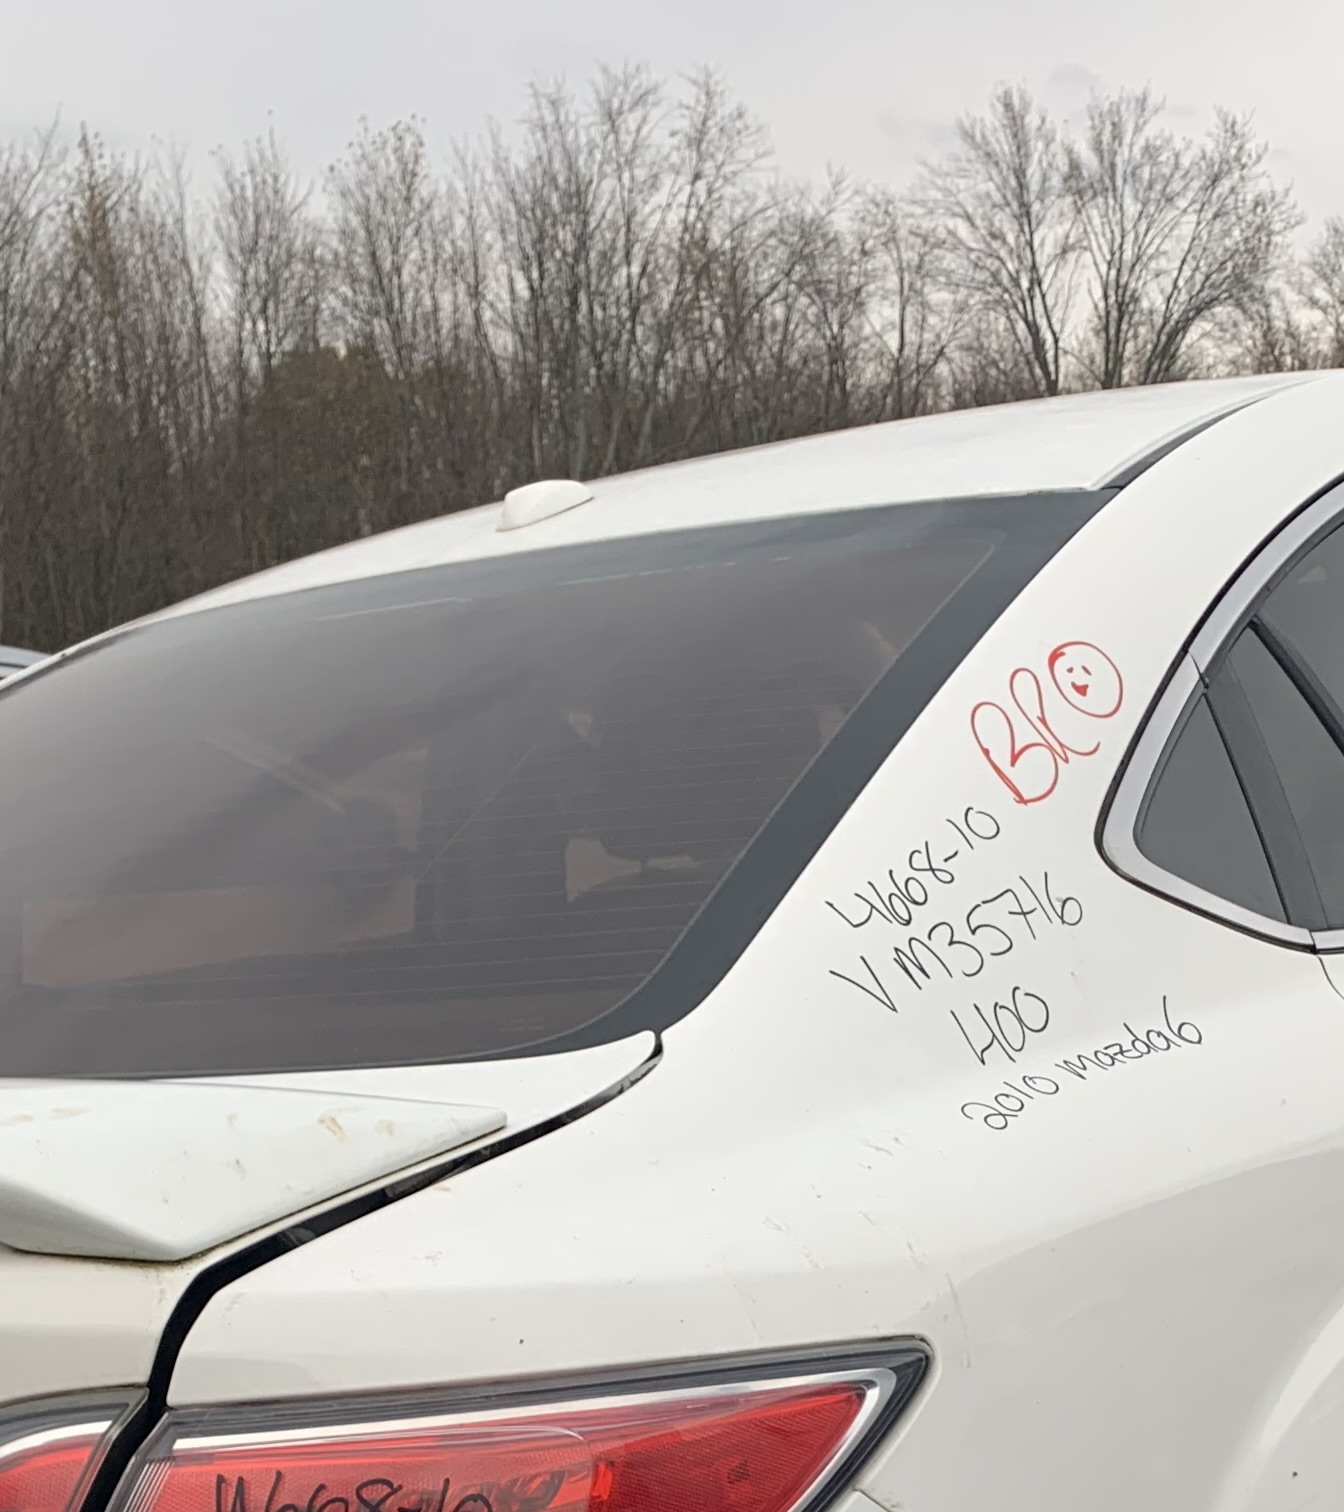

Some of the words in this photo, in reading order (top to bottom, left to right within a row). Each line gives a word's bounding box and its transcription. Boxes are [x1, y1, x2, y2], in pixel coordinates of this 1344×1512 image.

[826, 807, 1000, 928] 4668-10
[951, 987, 1049, 1065] 400
[961, 1075, 1059, 1130] 2010
